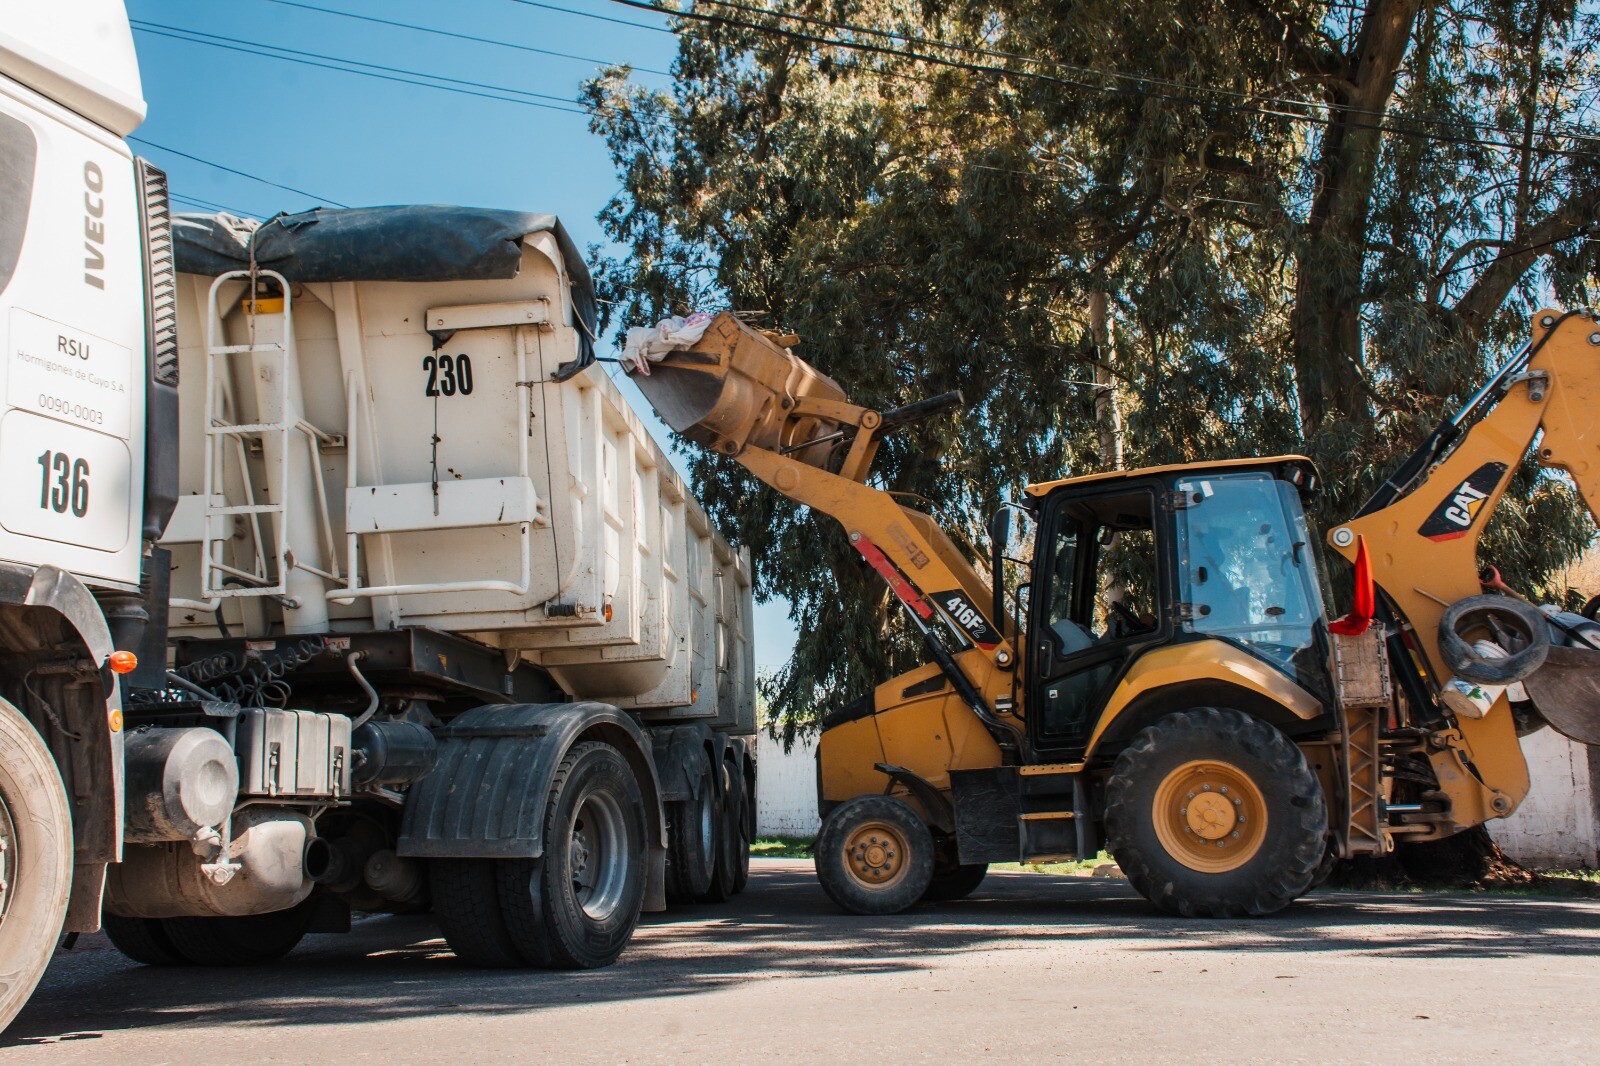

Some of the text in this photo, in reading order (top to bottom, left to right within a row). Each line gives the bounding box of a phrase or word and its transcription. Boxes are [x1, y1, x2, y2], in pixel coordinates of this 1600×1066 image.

[84, 160, 105, 291] IVECO
[16, 349, 73, 376] Hormigones
[75, 369, 87, 381] de
[88, 373, 110, 389] Cuyo
[57, 334, 90, 361] RSU
[422, 353, 474, 398] 230
[38, 393, 103, 425] 0090-0003
[37, 449, 90, 519] 136
[1444, 481, 1490, 527] CAT
